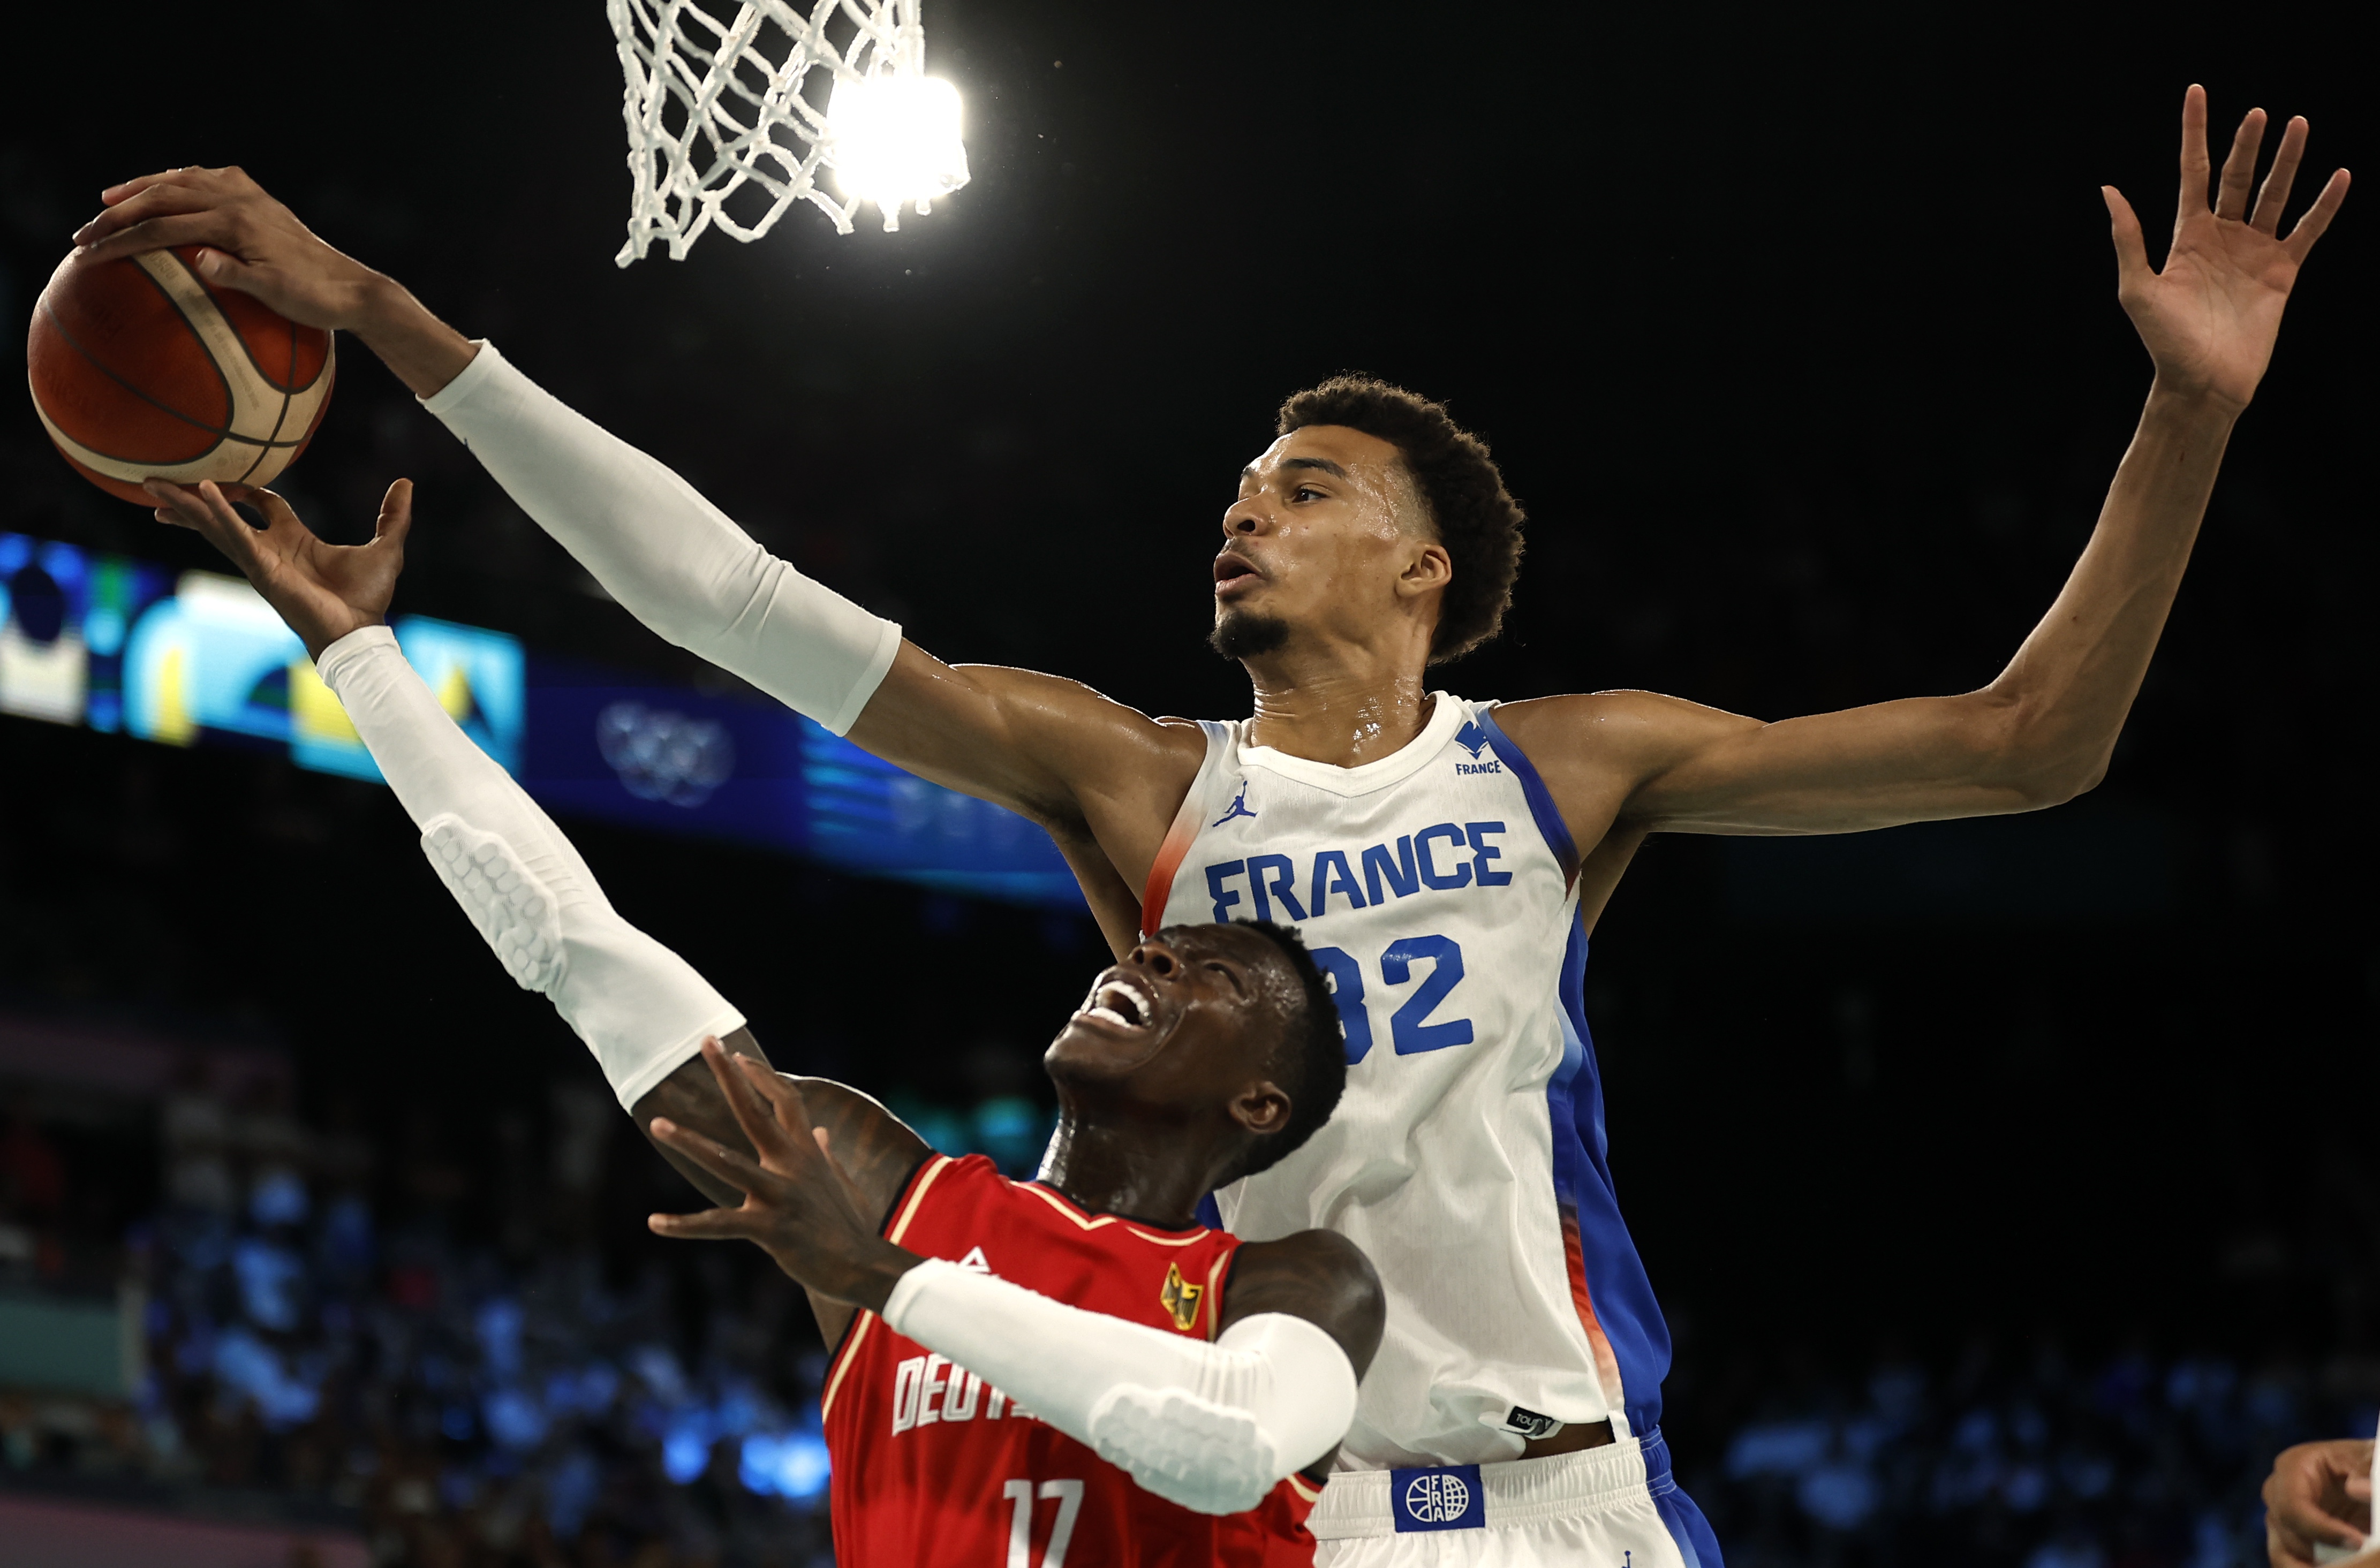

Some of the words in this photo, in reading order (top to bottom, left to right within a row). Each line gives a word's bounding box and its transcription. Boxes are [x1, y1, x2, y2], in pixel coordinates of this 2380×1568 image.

[1455, 760, 1501, 775] FRANCE
[1205, 821, 1512, 924] FRANCE
[1003, 1479, 1085, 1568] 17
[1431, 1475, 1445, 1522] FRA
